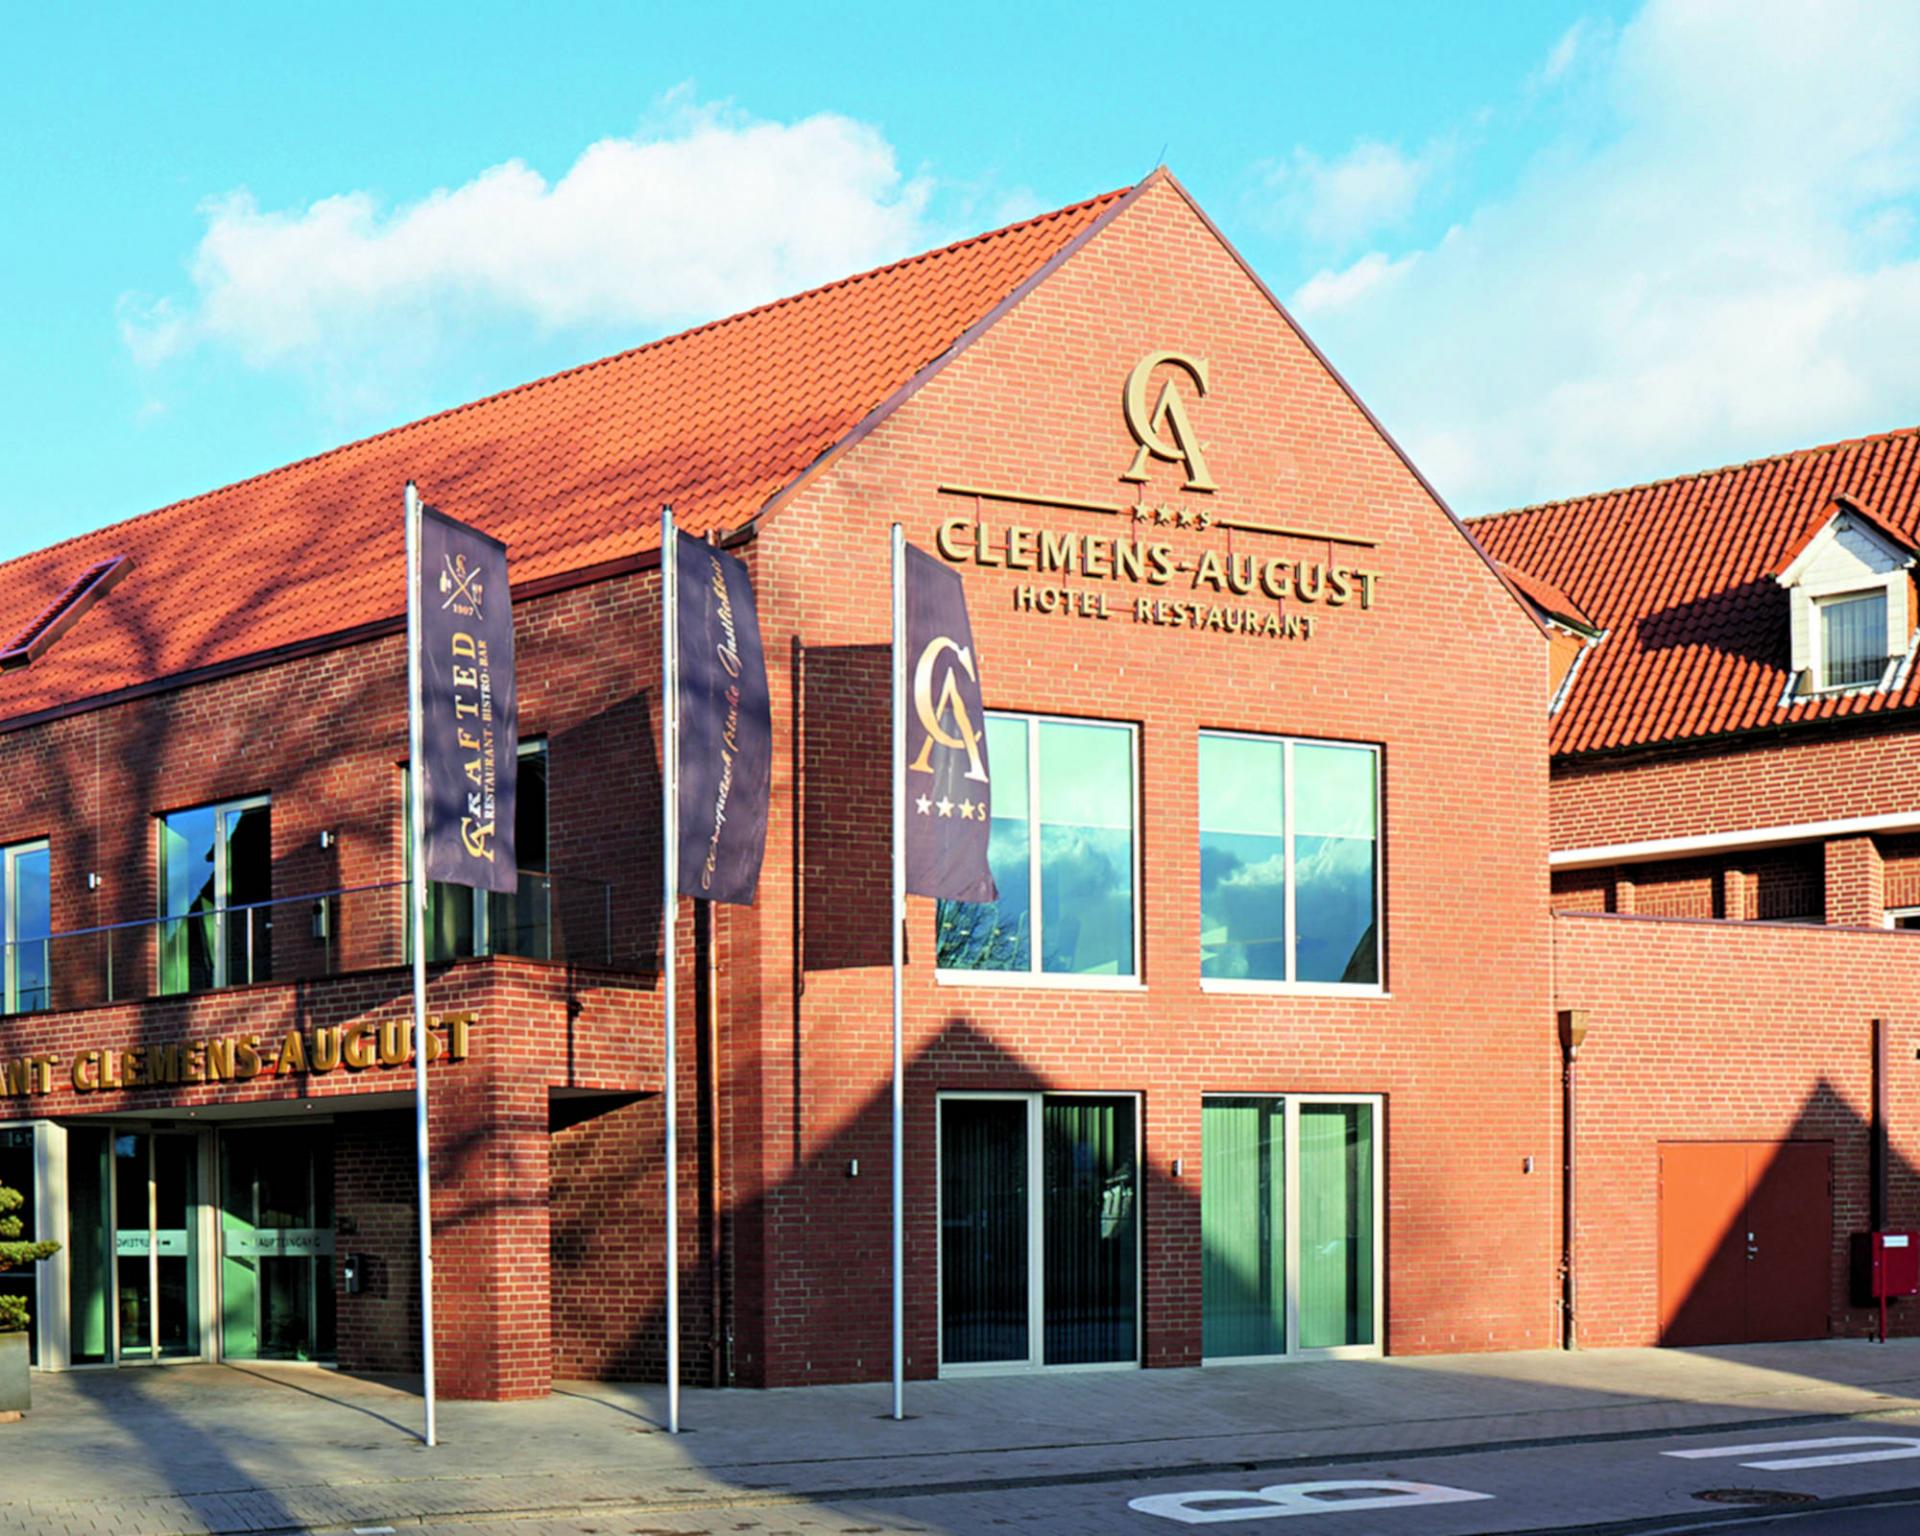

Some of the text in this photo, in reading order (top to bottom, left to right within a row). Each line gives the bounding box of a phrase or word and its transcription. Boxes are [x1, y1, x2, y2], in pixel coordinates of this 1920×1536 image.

[938, 516, 1383, 609] CLEMENS-AUGUST
[1014, 585, 1318, 641] HOTEL RESTAURANT
[478, 640, 496, 820] RESTAURANT BISTRO BAR
